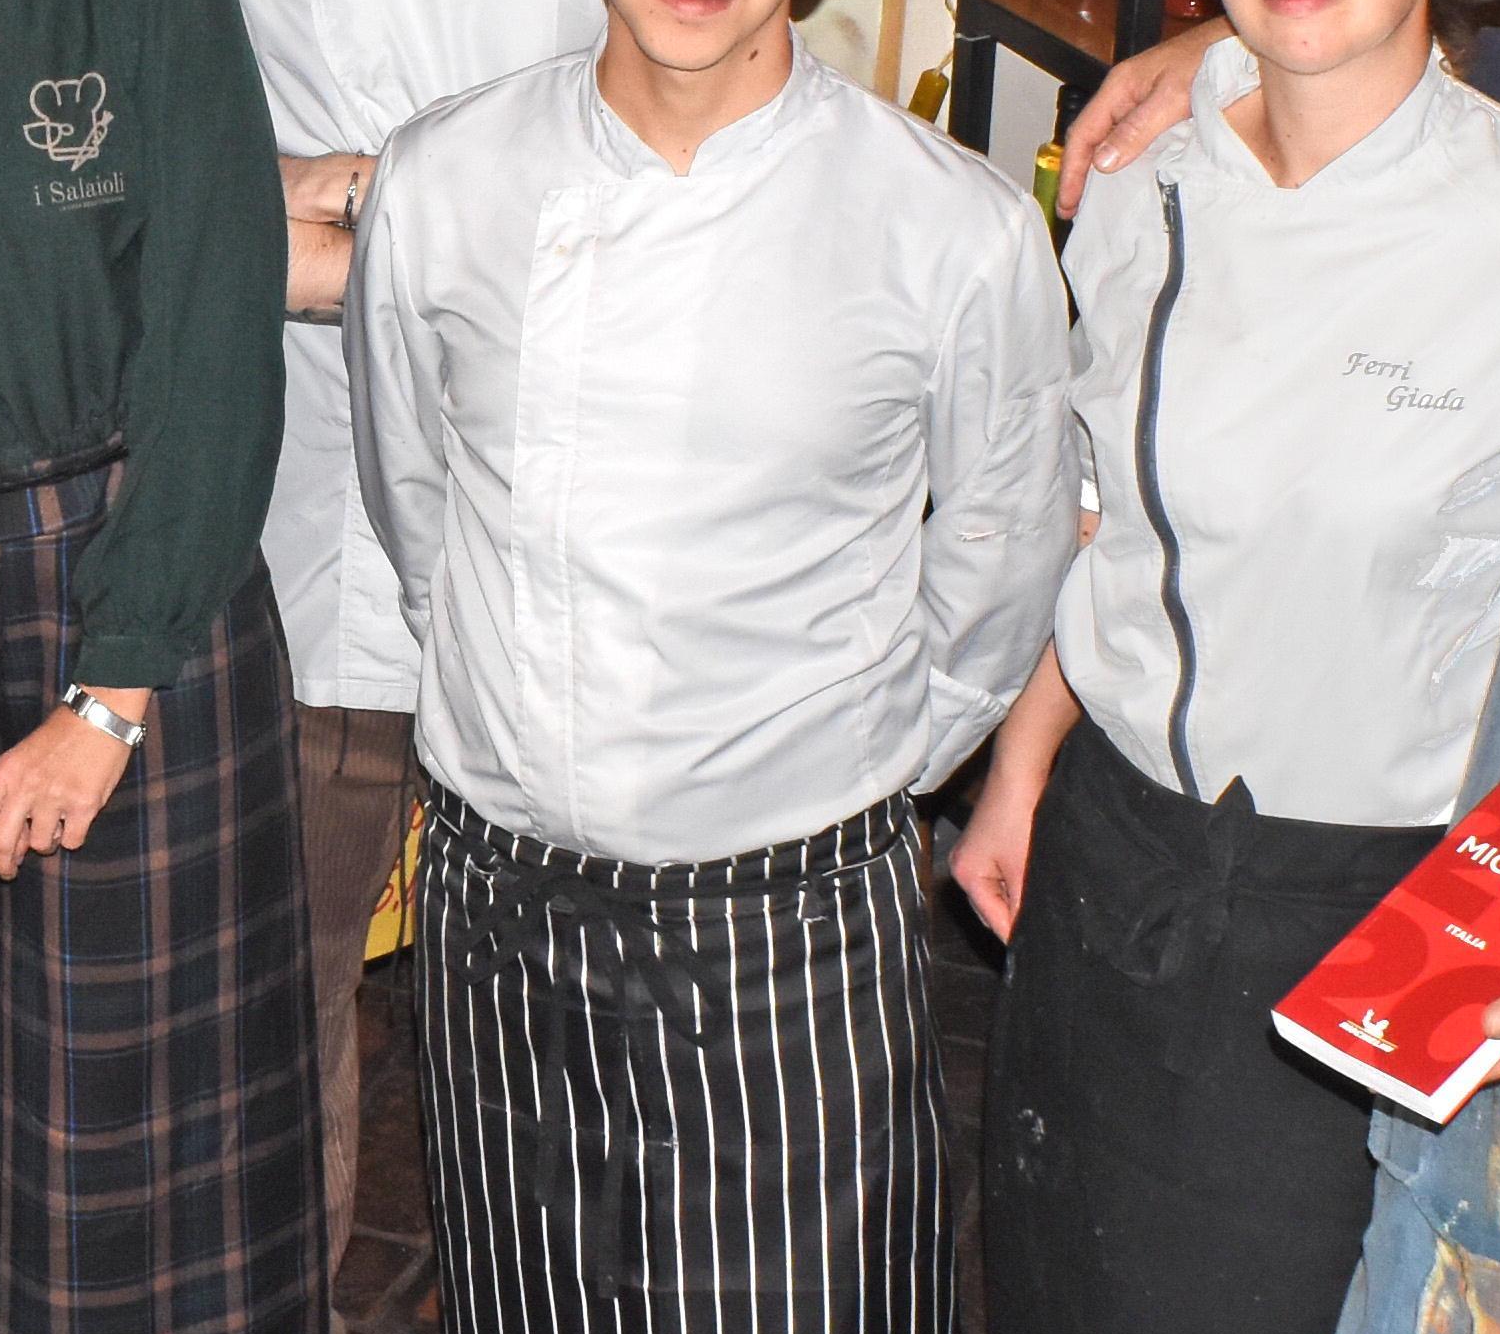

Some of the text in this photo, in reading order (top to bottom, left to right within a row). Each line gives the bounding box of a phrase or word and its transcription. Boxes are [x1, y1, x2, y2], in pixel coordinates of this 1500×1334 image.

[33, 184, 42, 207] i
[49, 172, 125, 204] Salaioli
[1341, 351, 1413, 381] Ferri
[1386, 385, 1465, 412] Giada
[1444, 923, 1487, 951] ITALIA
